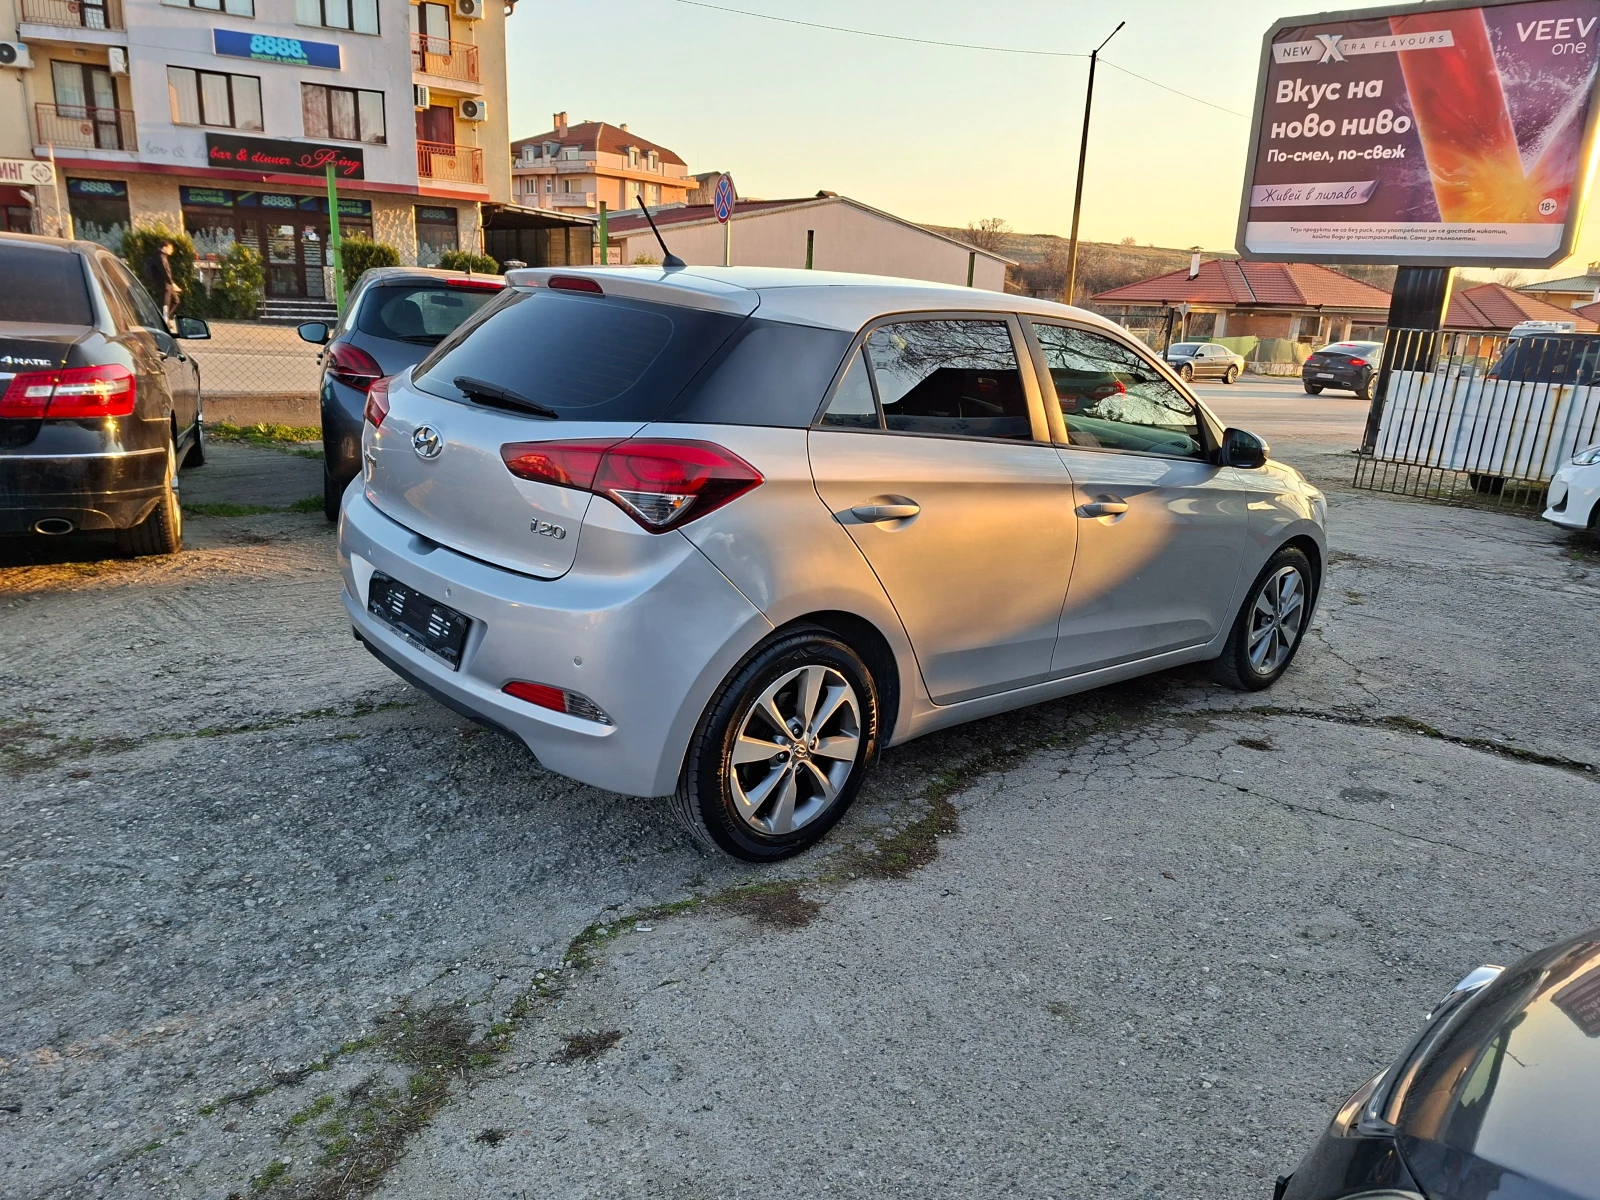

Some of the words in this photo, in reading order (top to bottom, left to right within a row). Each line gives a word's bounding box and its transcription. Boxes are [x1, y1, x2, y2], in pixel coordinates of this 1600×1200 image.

[1516, 16, 1598, 42] VEEV
[1282, 45, 1313, 58] NEW
[1374, 35, 1445, 49] FLAVOURS
[1551, 41, 1587, 56] one
[1275, 78, 1342, 109] Вкус
[1347, 79, 1384, 99] на
[1270, 112, 1336, 139] ново
[1340, 108, 1412, 136] ниво
[209, 145, 232, 160] bar
[236, 148, 248, 161] &
[251, 151, 292, 165] dinner
[1267, 149, 1335, 163] По-смел,
[1337, 144, 1407, 161] по-свеж
[188, 195, 225, 204] GAMES
[1260, 187, 1302, 202] Живей
[1305, 187, 1316, 201] в
[1315, 186, 1358, 201] лилаво
[1540, 202, 1557, 211] 18+
[1289, 226, 1303, 234] Тези
[1303, 226, 1332, 234] продукти
[1348, 226, 1358, 234] без
[1331, 233, 1346, 241] води
[0, 355, 52, 366] 4MATIC
